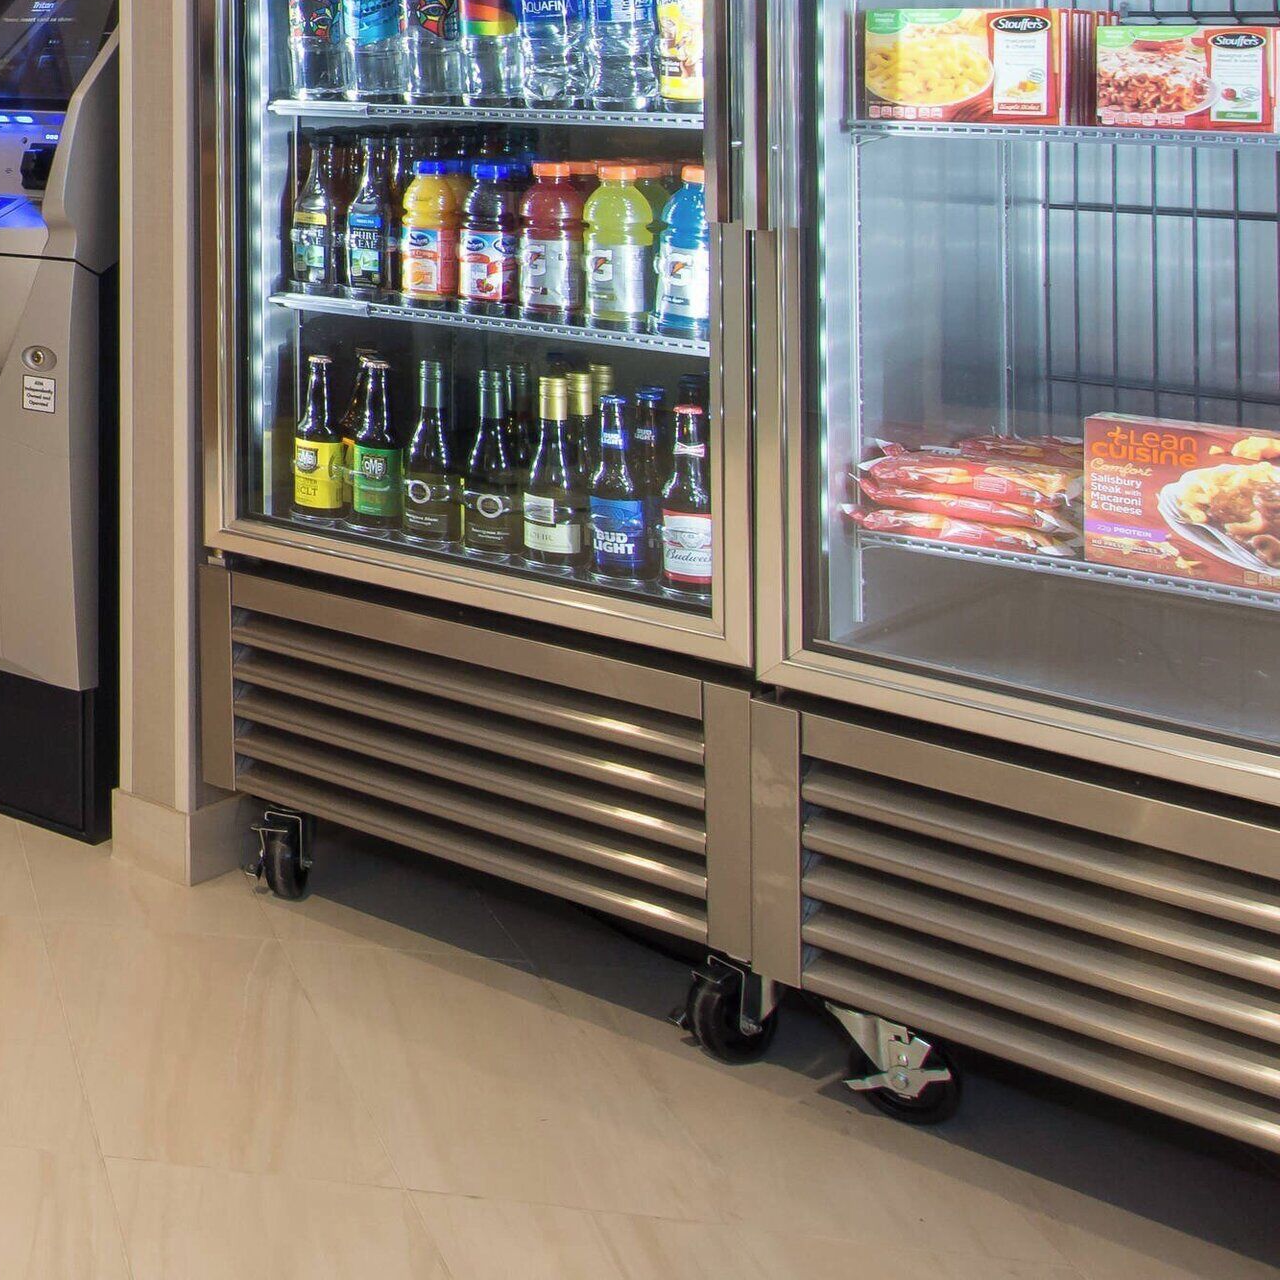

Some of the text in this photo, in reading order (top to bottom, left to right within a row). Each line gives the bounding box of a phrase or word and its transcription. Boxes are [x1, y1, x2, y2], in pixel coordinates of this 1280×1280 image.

[522, 0, 572, 13] AQUAFINA
[997, 18, 1044, 31] Stouffer's
[1215, 34, 1260, 48] Stouffer's
[1129, 429, 1198, 452] Lean
[1090, 458, 1153, 477] Comfort
[1090, 472, 1142, 489] Salisbury
[1090, 483, 1142, 497] Steak with
[1090, 492, 1142, 506] Macaroni
[1090, 501, 1143, 516] & Cheese
[596, 530, 628, 543] BUD
[1113, 527, 1153, 538] PROTEIN
[594, 541, 635, 555] LIGHT
